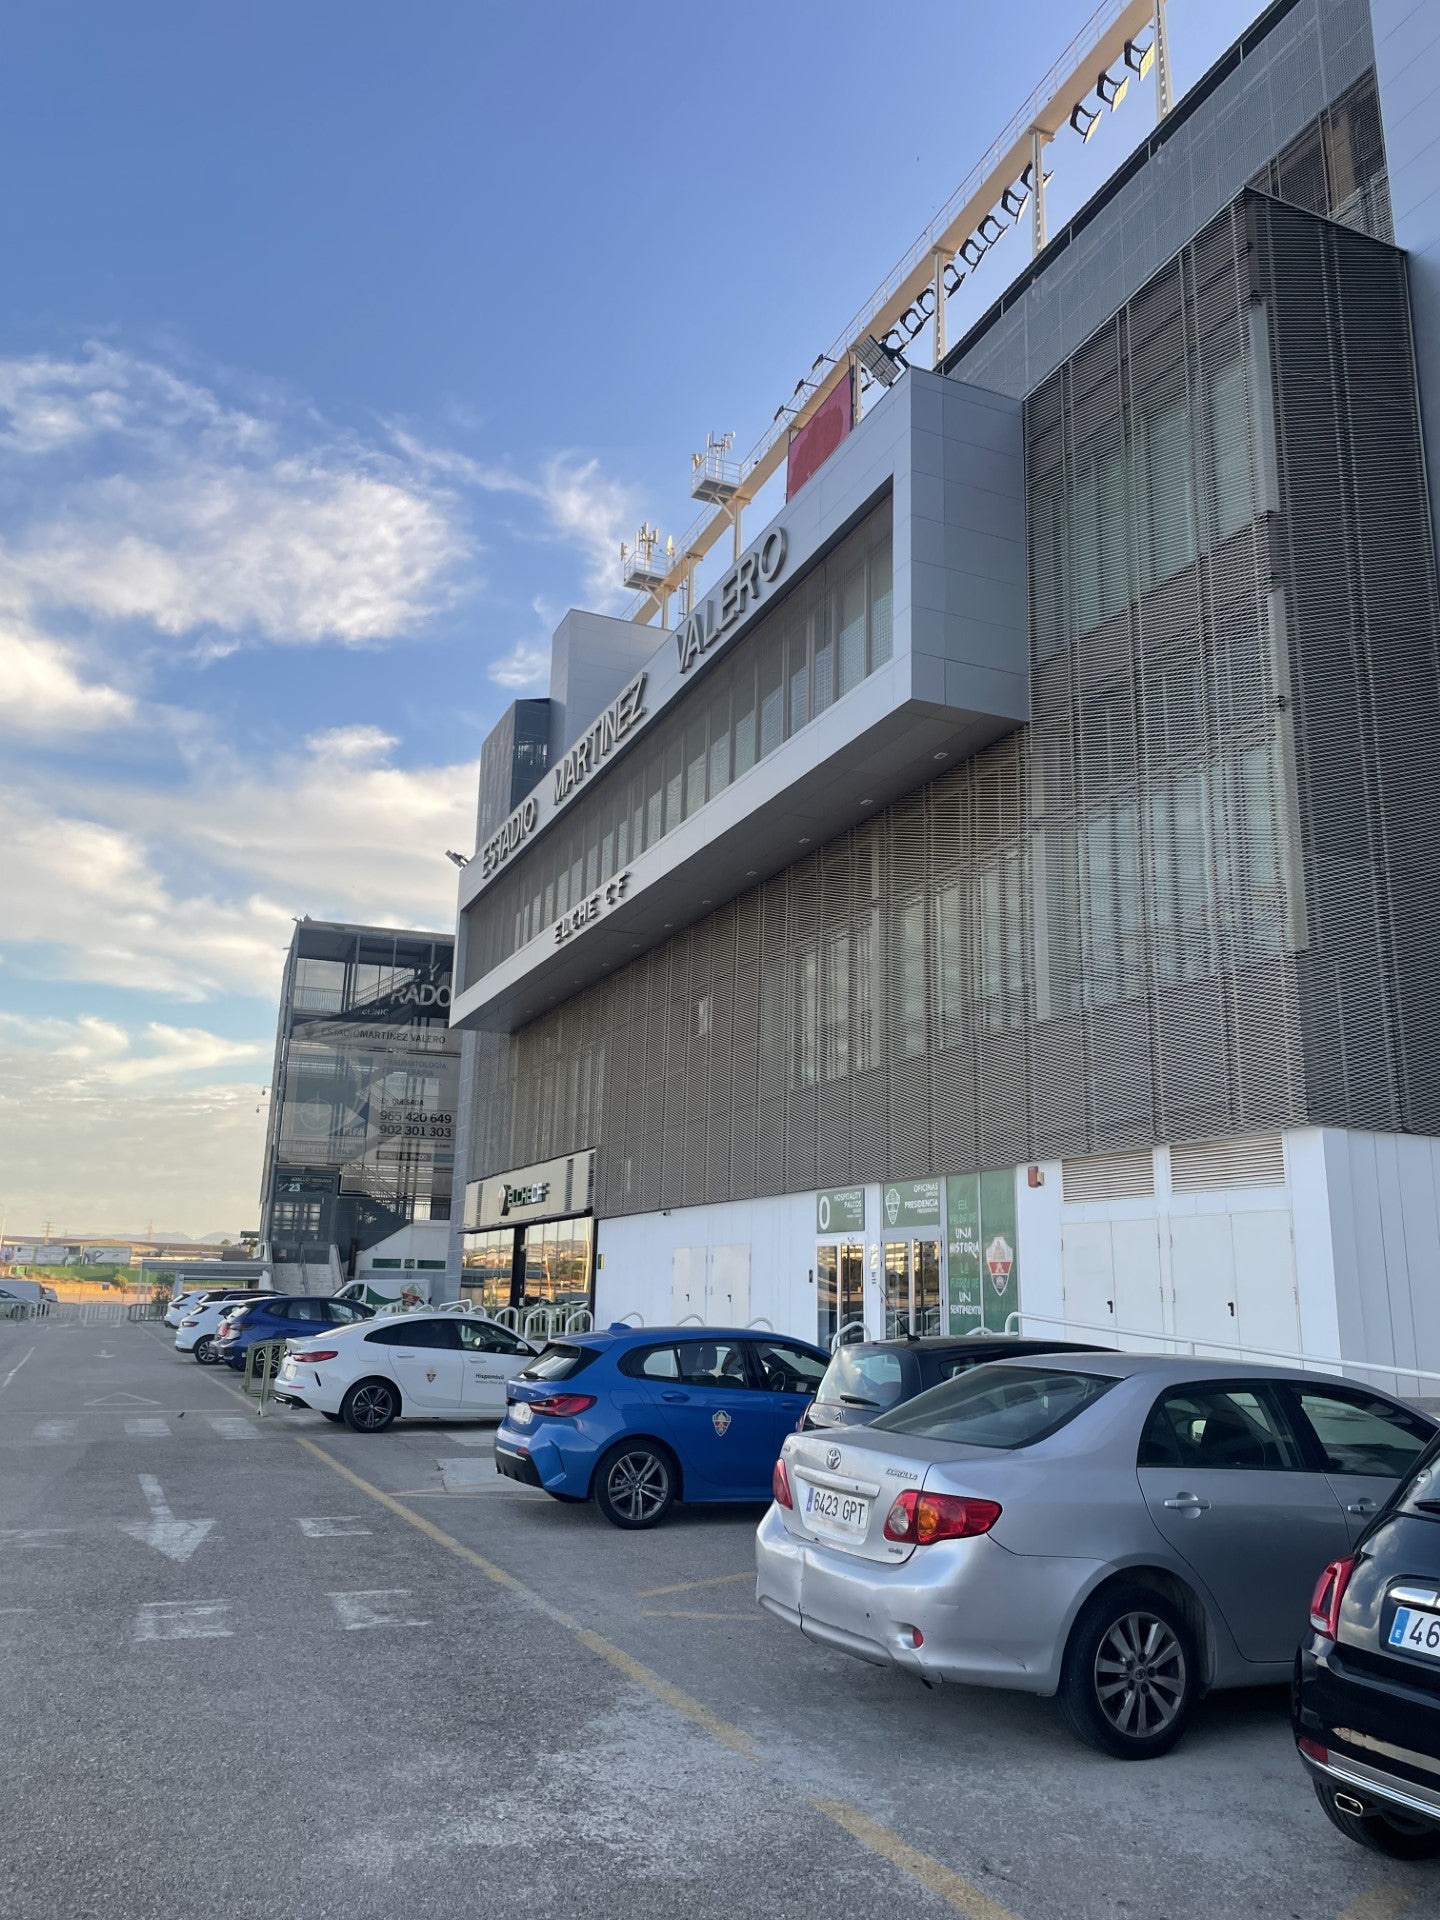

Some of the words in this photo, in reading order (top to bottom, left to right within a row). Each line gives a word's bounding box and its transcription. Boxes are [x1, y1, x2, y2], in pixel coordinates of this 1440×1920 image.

[482, 797, 538, 879] ESTADIO
[553, 672, 649, 806] MARTINEZ
[676, 527, 787, 674] VALERO
[554, 894, 601, 944] ELCHE
[380, 1110, 402, 1121] 965
[405, 1111, 427, 1123] 420
[430, 1113, 452, 1125] 649
[379, 1124, 402, 1135] 902
[405, 1125, 427, 1136] 301
[429, 1127, 452, 1138] 303
[288, 1183, 301, 1192] 23
[913, 1182, 939, 1193] OFICINAS
[904, 1199, 939, 1210] PRESIDENCIA
[955, 1227, 972, 1239] UNA
[949, 1241, 979, 1259] HISTORIA
[958, 1292, 971, 1303] UN
[813, 1491, 840, 1517] 6423
[842, 1499, 866, 1525] GPT
[1394, 1629, 1402, 1638] E
[1409, 1617, 1440, 1649] 46
